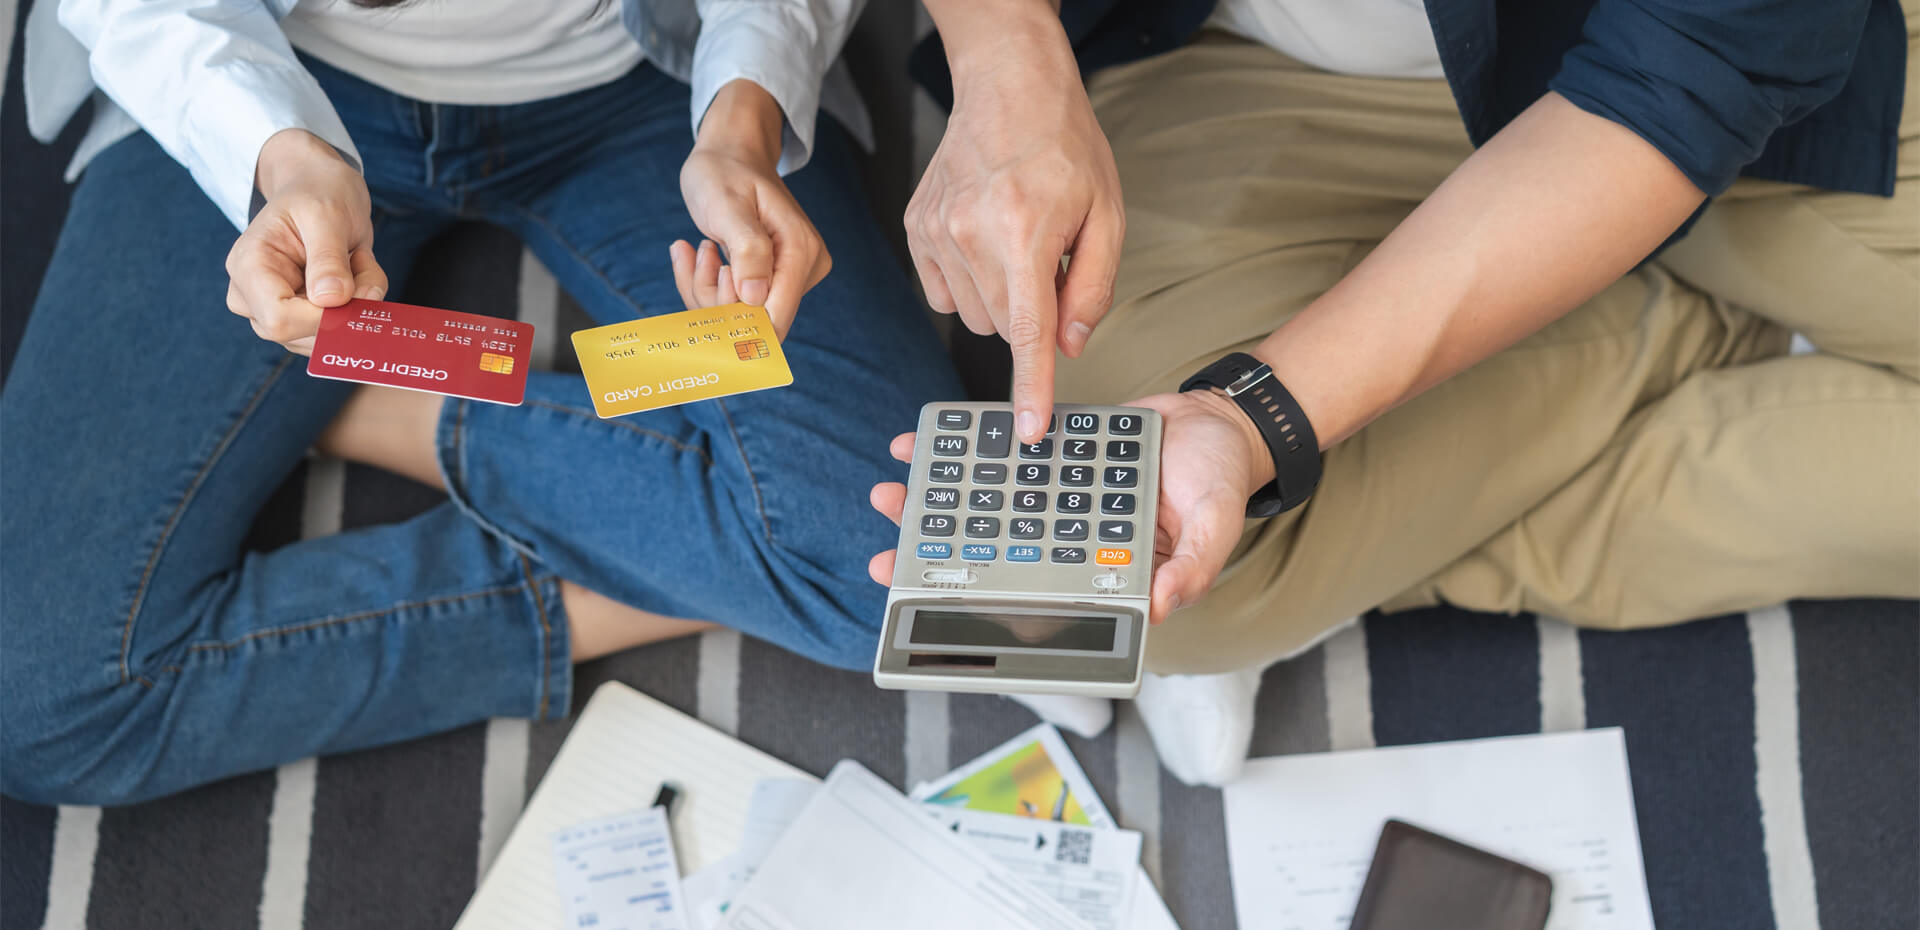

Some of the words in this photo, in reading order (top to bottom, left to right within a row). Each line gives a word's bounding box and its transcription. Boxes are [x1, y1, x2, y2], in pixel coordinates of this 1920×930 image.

[347, 321, 383, 333] 3456
[391, 326, 426, 339] 9012
[728, 326, 759, 339] 1234
[436, 333, 471, 346] 5678
[481, 340, 516, 352] 1234
[647, 341, 679, 353] 9012
[322, 354, 375, 370] CARD
[379, 362, 448, 381] CREDIT
[657, 373, 719, 394] CREDIT
[604, 385, 653, 403] CARD
[1071, 415, 1093, 428] 00
[1119, 417, 1131, 429] 0
[937, 439, 962, 449] M+
[1029, 440, 1042, 452] 3
[1074, 441, 1085, 454] 2
[1120, 443, 1127, 455] 1
[1027, 467, 1039, 479] 6
[1071, 468, 1083, 480] 5
[1114, 469, 1127, 481] 4
[927, 491, 955, 502] MRC
[1023, 493, 1035, 506] 9
[1068, 494, 1080, 507] 8
[1112, 496, 1124, 508] 7
[926, 518, 948, 528] GT
[921, 545, 947, 553] TAX+
[965, 546, 991, 555] TAX-
[1015, 548, 1034, 556] SET
[1101, 551, 1126, 560] C/CE
